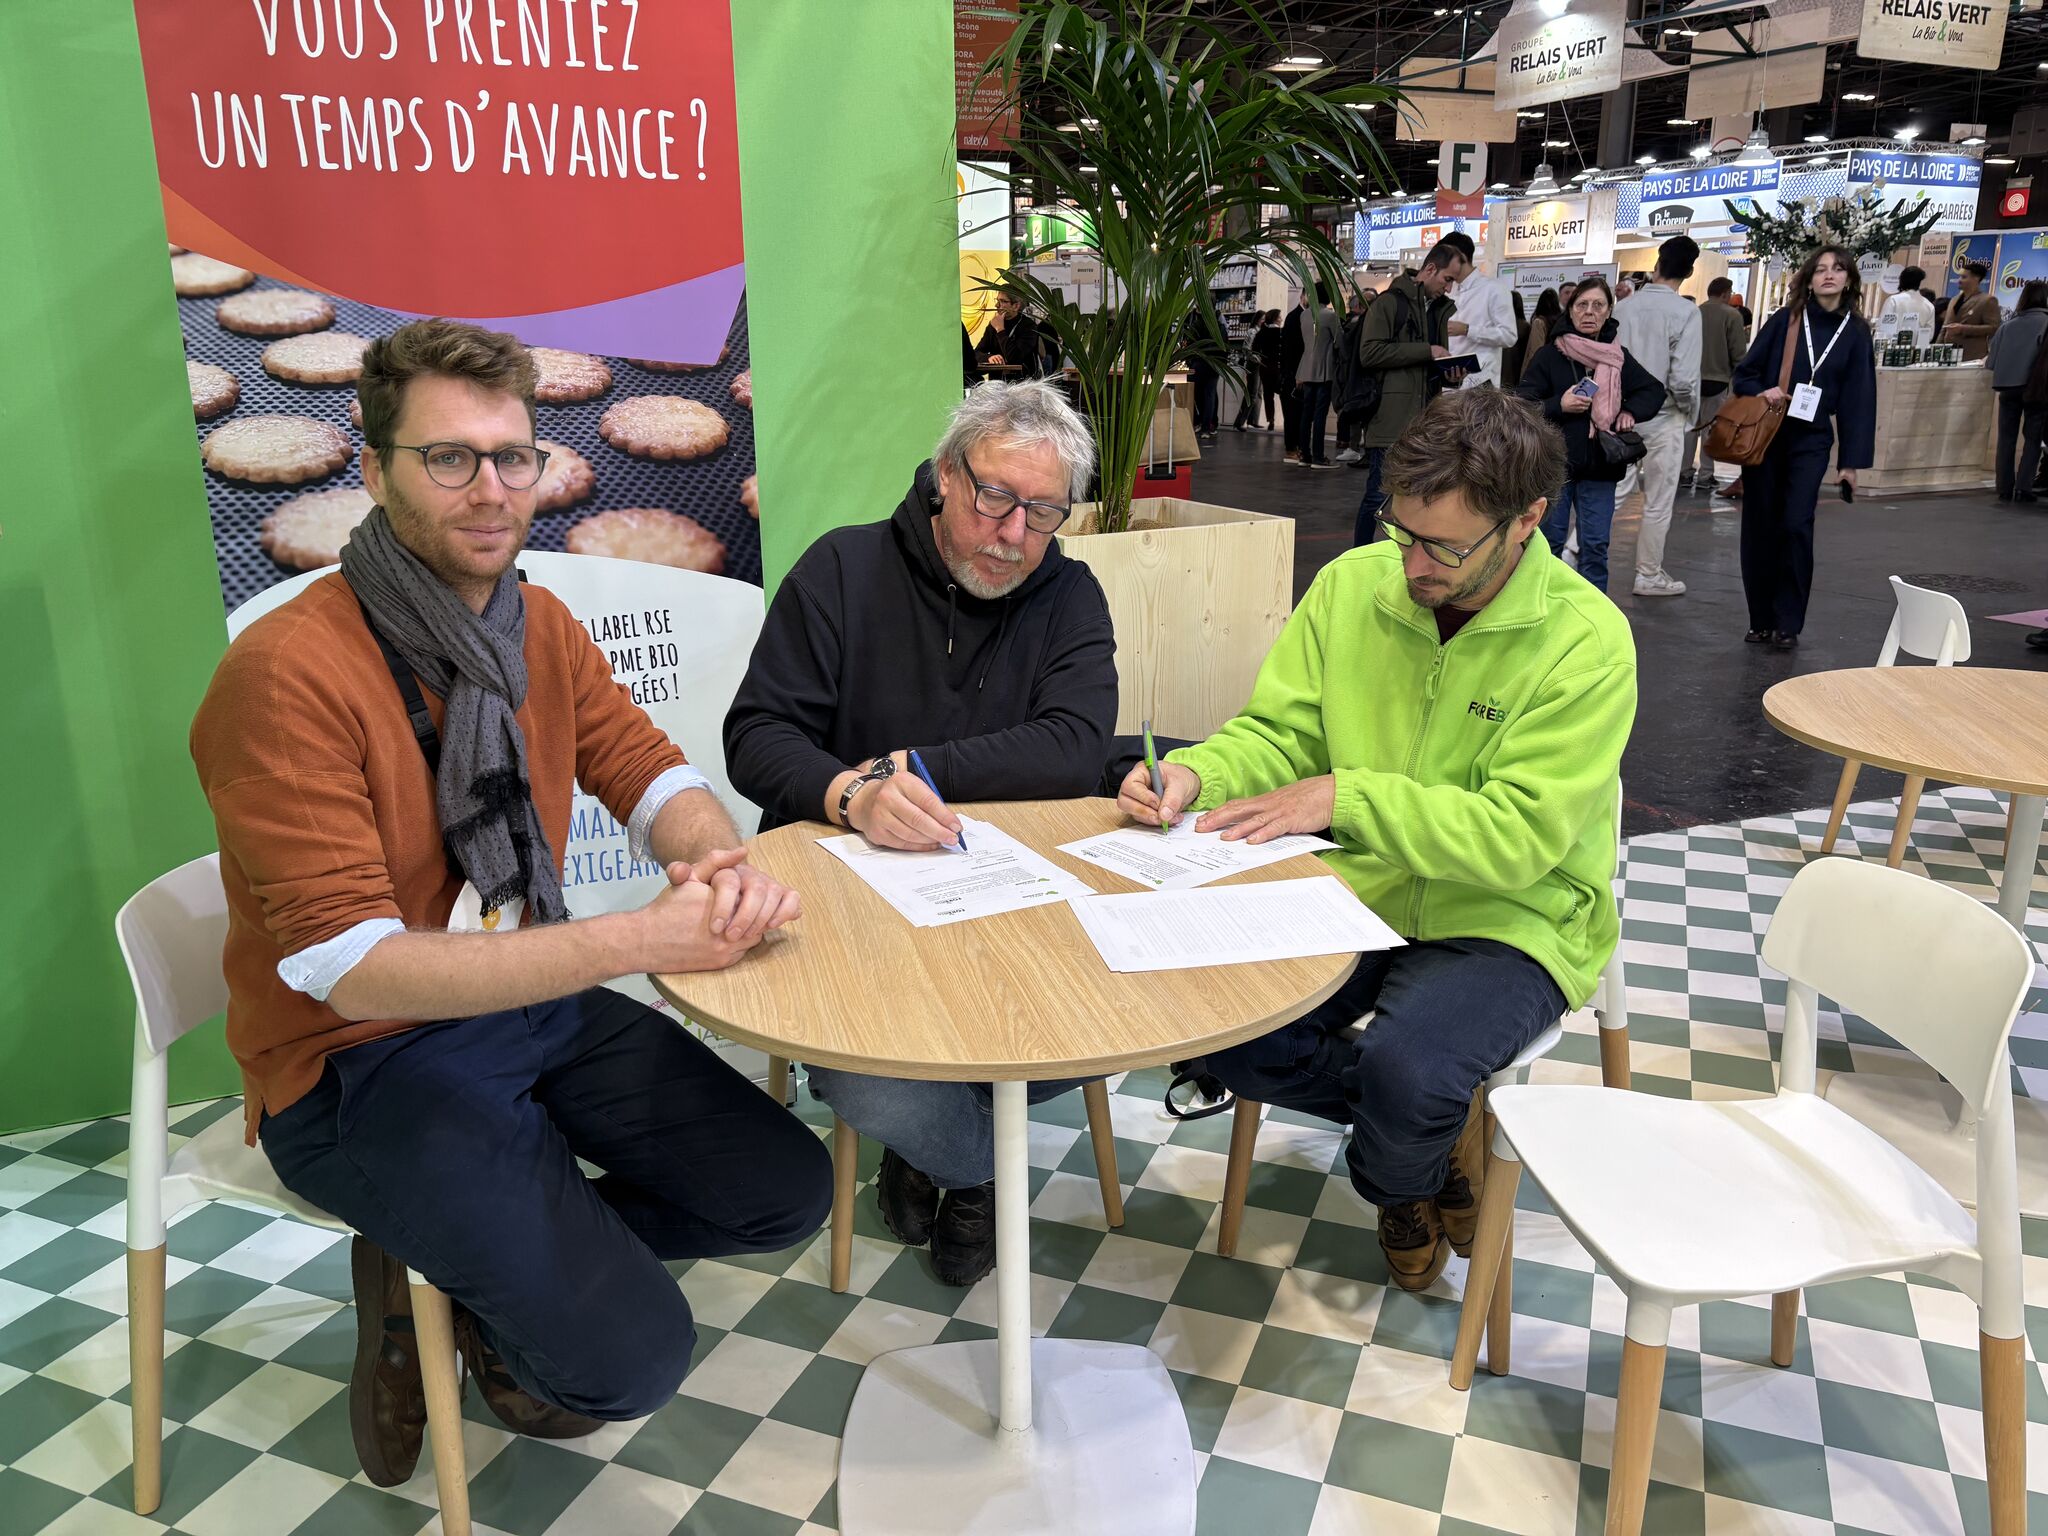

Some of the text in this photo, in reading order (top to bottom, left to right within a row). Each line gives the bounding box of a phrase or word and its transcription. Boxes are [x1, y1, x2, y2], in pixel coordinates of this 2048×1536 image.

[1881, 0, 1991, 26] RELAIS VERT
[252, 0, 640, 71] VOUS PRENIEZ
[1510, 36, 1544, 52] GROUPE
[1912, 25, 1922, 39] La
[1923, 26, 1937, 40] Bio
[1948, 29, 1964, 42] Vous
[1510, 36, 1608, 74] RELAIS VERT
[190, 90, 268, 169] UN
[280, 93, 434, 173] TEMPS
[1451, 143, 1476, 192] F
[1851, 158, 1955, 181] PAYS DE LA LOIRE
[1642, 170, 1749, 198] PAYS DE LA LOIRE
[1371, 210, 1390, 227] PAYS
[1391, 211, 1401, 224] DE
[1402, 208, 1416, 223] LA
[1416, 206, 1437, 221] LOIRE
[1508, 212, 1535, 223] GROUPE
[1508, 219, 1585, 240] RELAIS VERT
[591, 609, 673, 643] LABEL RSE
[610, 643, 679, 675] PME BIO
[569, 806, 627, 843] MAI
